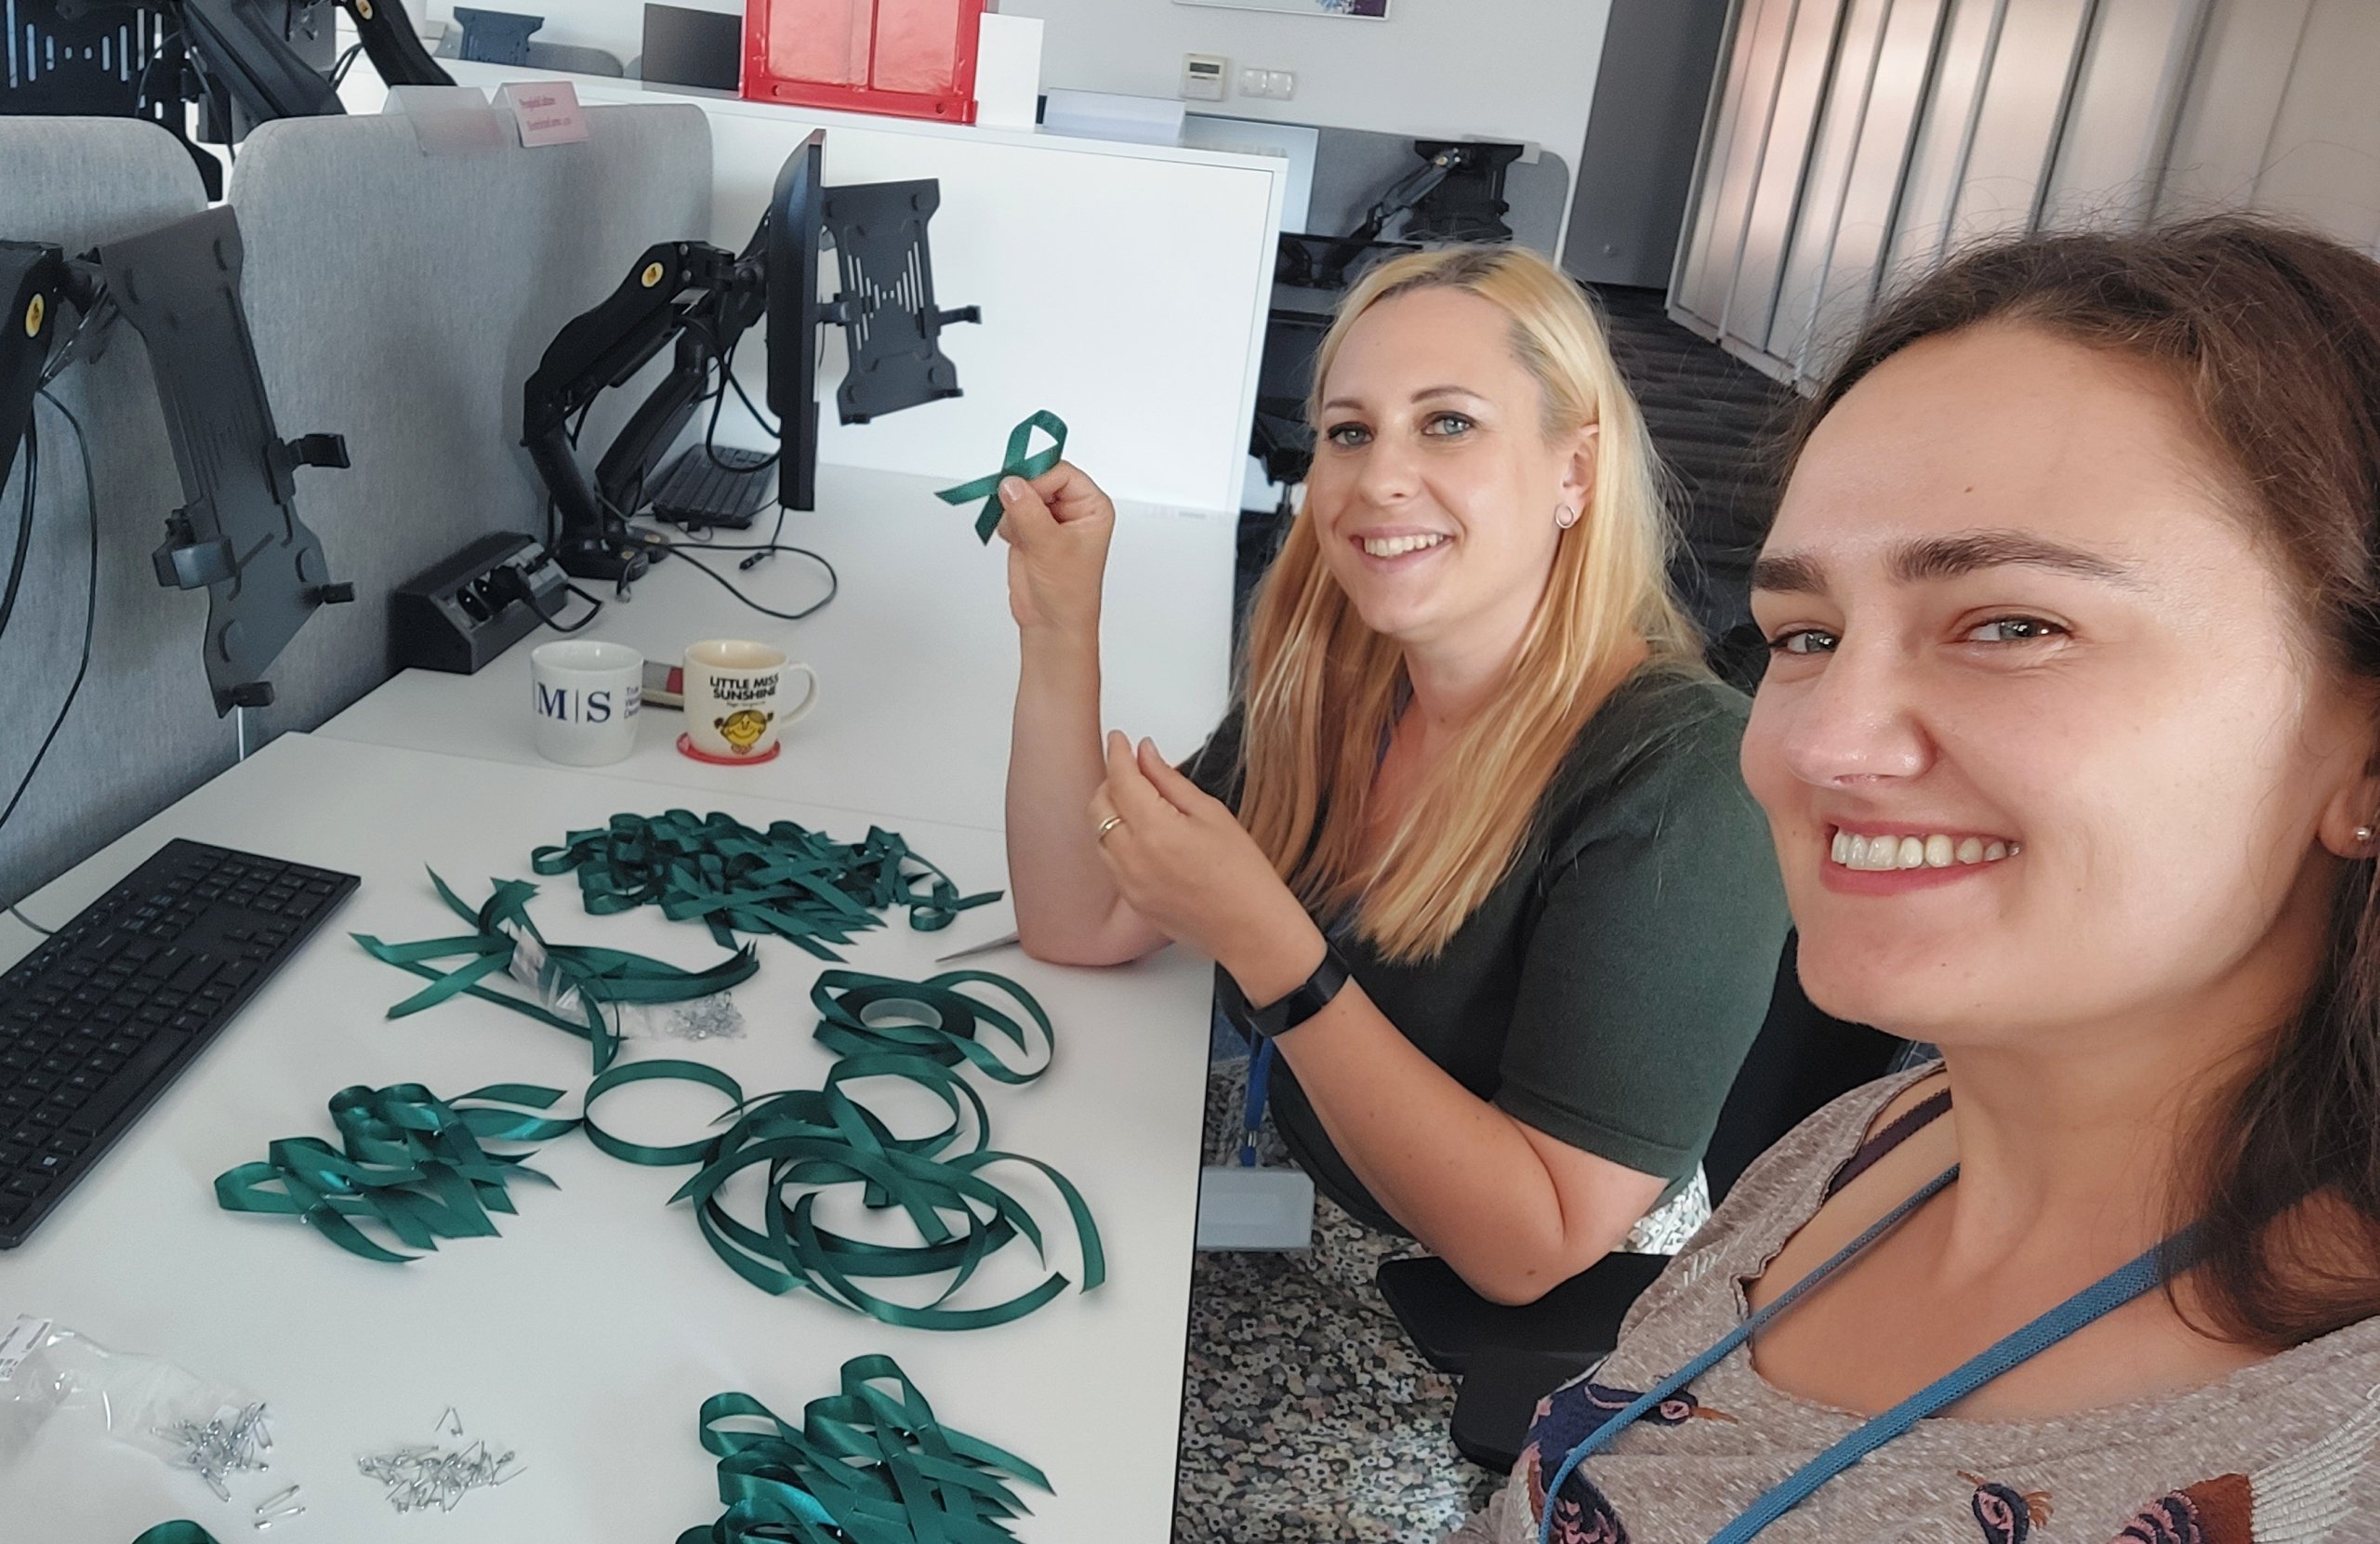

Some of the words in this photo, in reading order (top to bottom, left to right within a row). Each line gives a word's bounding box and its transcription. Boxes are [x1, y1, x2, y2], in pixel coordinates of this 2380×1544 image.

[709, 675, 749, 689] LITTLE
[754, 672, 779, 688] MISS
[713, 684, 775, 700] SUNSHINE
